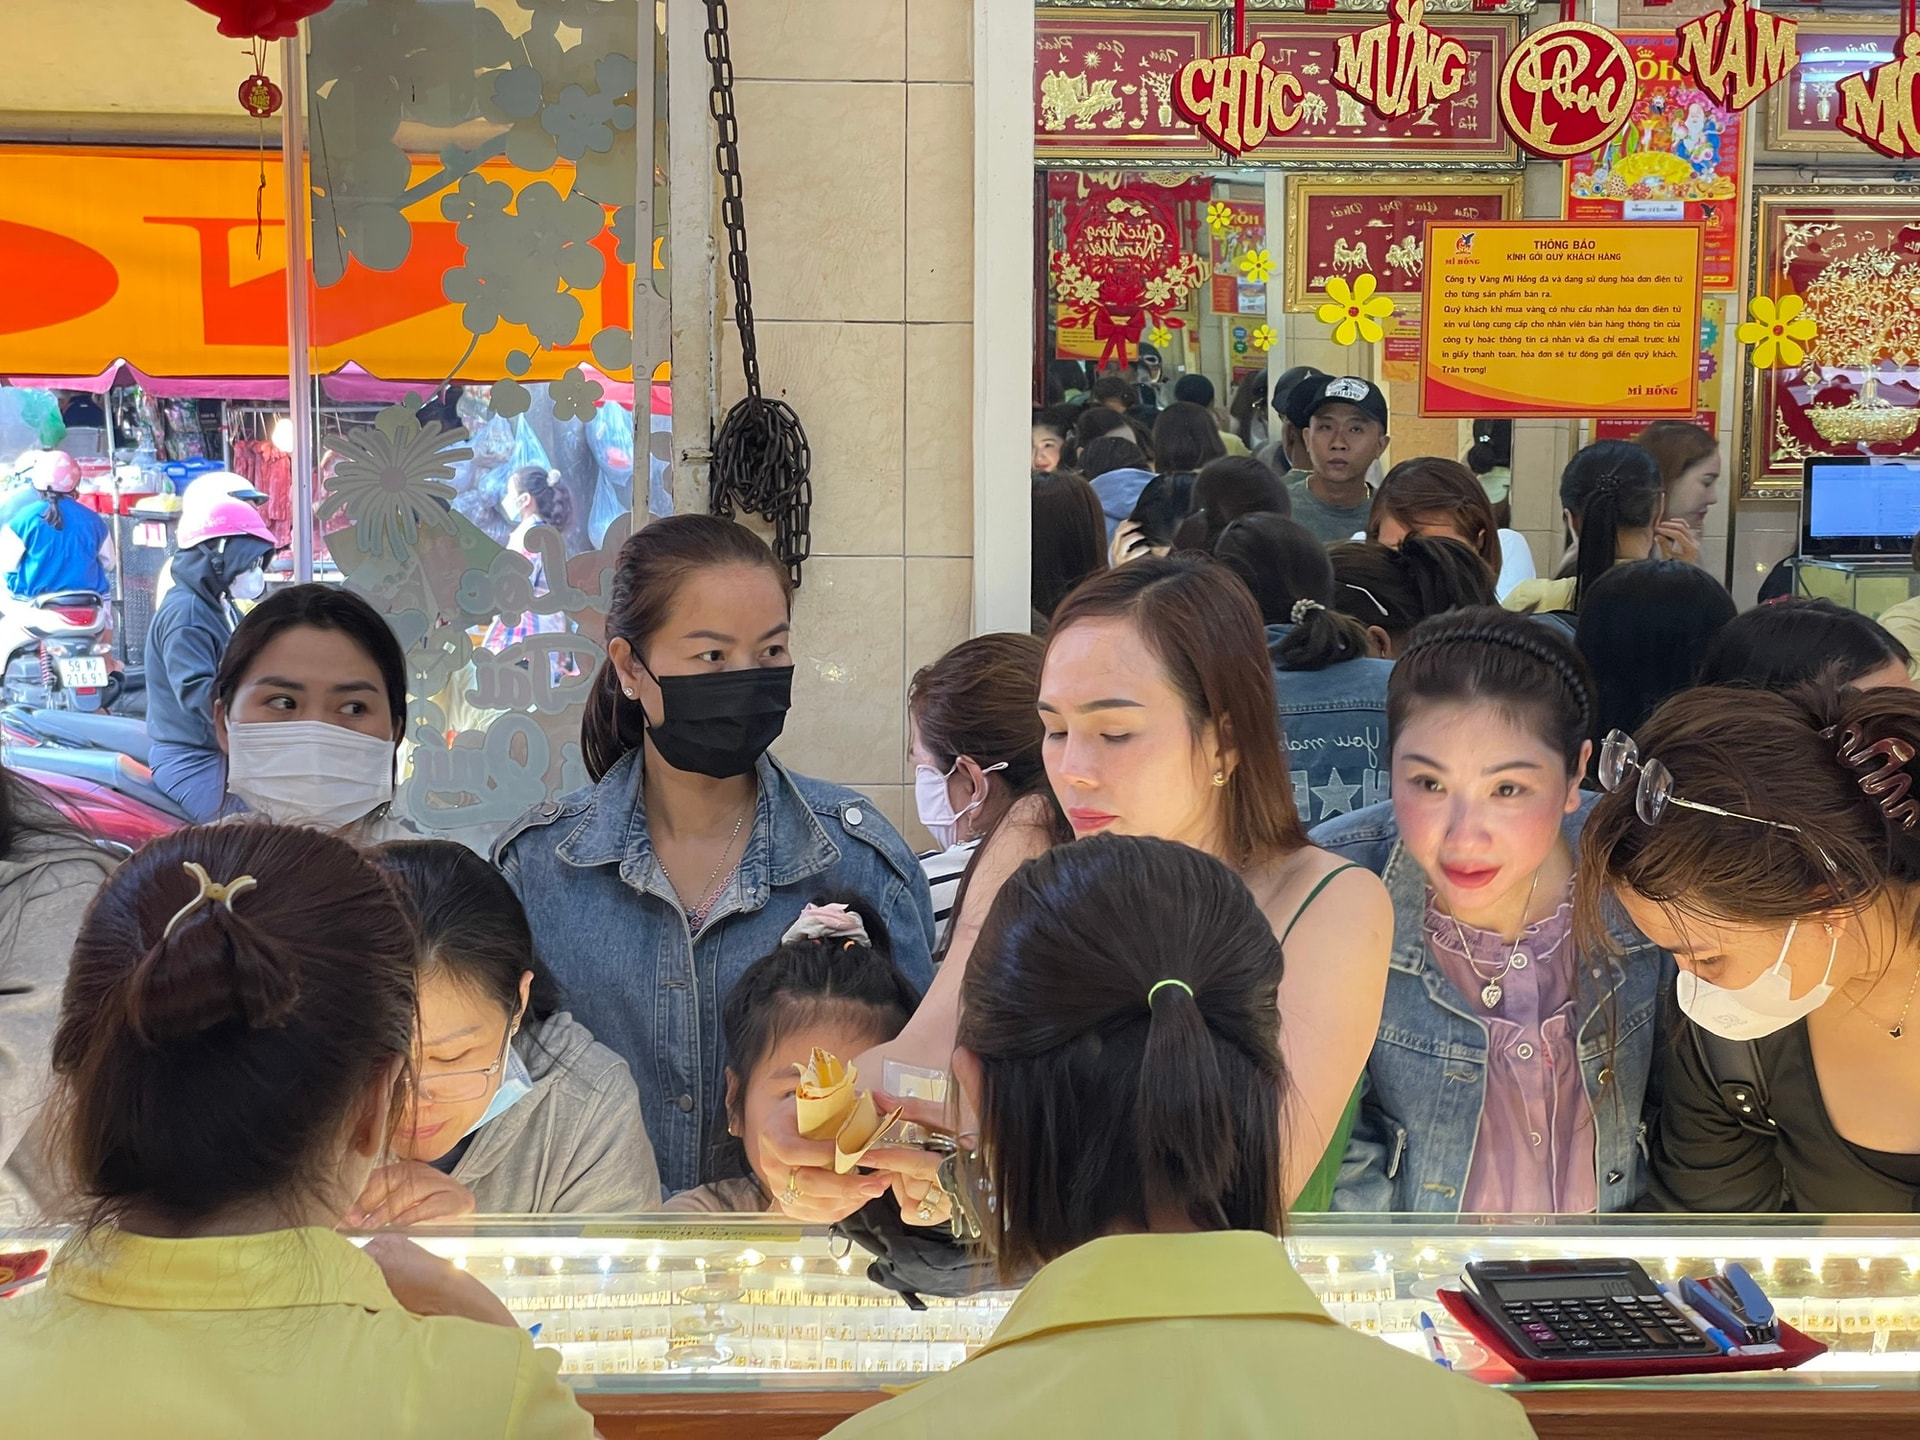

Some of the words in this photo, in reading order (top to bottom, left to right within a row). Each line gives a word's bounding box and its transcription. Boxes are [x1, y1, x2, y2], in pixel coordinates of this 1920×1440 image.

[1180, 40, 1304, 151] CHÚC
[1533, 238, 1569, 250] THÔNG
[1572, 238, 1596, 250] BÁO
[1506, 252, 1526, 261] KÍNH
[1545, 252, 1564, 261] QUÝ
[1566, 252, 1595, 261] KHÁCH
[1598, 252, 1621, 261] HÀNG
[1445, 275, 1464, 285] Công
[1467, 276, 1477, 285] ty
[1479, 275, 1500, 285] Vàng
[1516, 274, 1537, 285] Hồng
[1539, 275, 1549, 283] đã
[1564, 275, 1584, 285] đang
[1586, 275, 1596, 283] sử
[1620, 275, 1635, 283] hóa
[1637, 275, 1652, 283] đơn
[1444, 290, 1458, 298] cho
[1482, 290, 1497, 298] sản
[1524, 290, 1539, 298] bán
[1443, 305, 1461, 315] Quý
[1464, 305, 1488, 313] khách
[1490, 305, 1503, 313] khi
[1548, 305, 1558, 313] có
[1560, 305, 1576, 313] nhu
[1617, 305, 1632, 313] hóa
[1634, 305, 1650, 313] đơn
[1443, 320, 1456, 328] xin
[1458, 320, 1470, 328] vui
[1472, 320, 1490, 330] lòng
[1492, 322, 1512, 330] cung
[1514, 320, 1528, 330] cấp
[1530, 320, 1545, 328] cho
[1546, 320, 1566, 328] nhân
[1568, 320, 1586, 328] viên
[1588, 320, 1603, 328] bán
[1605, 320, 1625, 330] hàng
[1627, 320, 1650, 330] thông
[1653, 320, 1664, 328] tin
[1666, 319, 1681, 328] của
[1442, 336, 1461, 345] công
[1464, 336, 1474, 345] ty
[1499, 335, 1522, 345] thông
[1552, 335, 1572, 343] nhân
[1618, 335, 1640, 343] email
[1667, 335, 1680, 343] khi
[1442, 350, 1450, 358] in
[1452, 350, 1469, 360] giấy
[1472, 350, 1495, 358] thanh
[1520, 350, 1535, 358] hóa
[1538, 350, 1552, 358] đơn
[1616, 350, 1631, 358] đến
[1634, 350, 1650, 360] quý
[1652, 350, 1678, 358] khách.
[1442, 365, 1460, 375] Trân
[68, 659, 81, 672] 59
